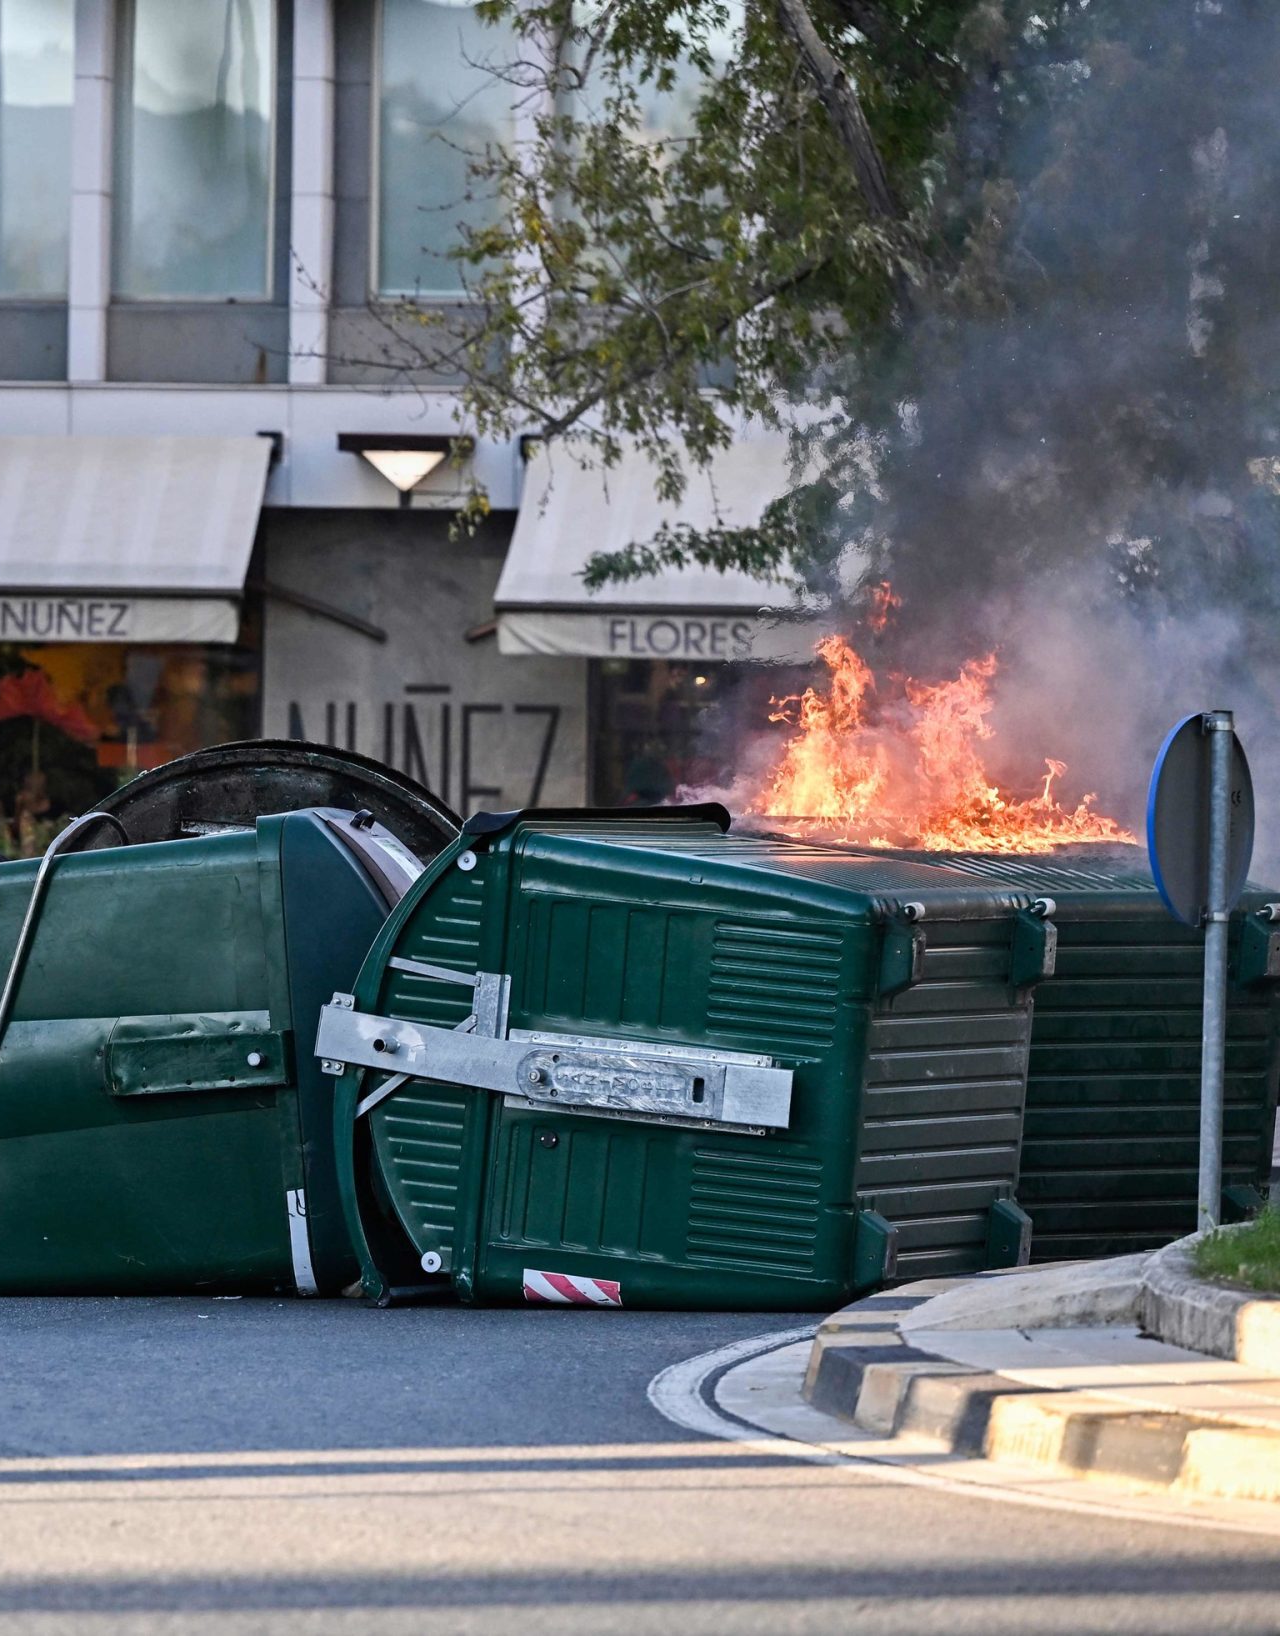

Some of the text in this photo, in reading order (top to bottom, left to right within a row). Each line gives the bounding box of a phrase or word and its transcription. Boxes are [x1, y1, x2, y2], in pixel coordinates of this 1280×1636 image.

[0, 599, 129, 635] NUÑEZ
[609, 618, 752, 655] FLORES
[289, 684, 561, 820] ÑEZ
